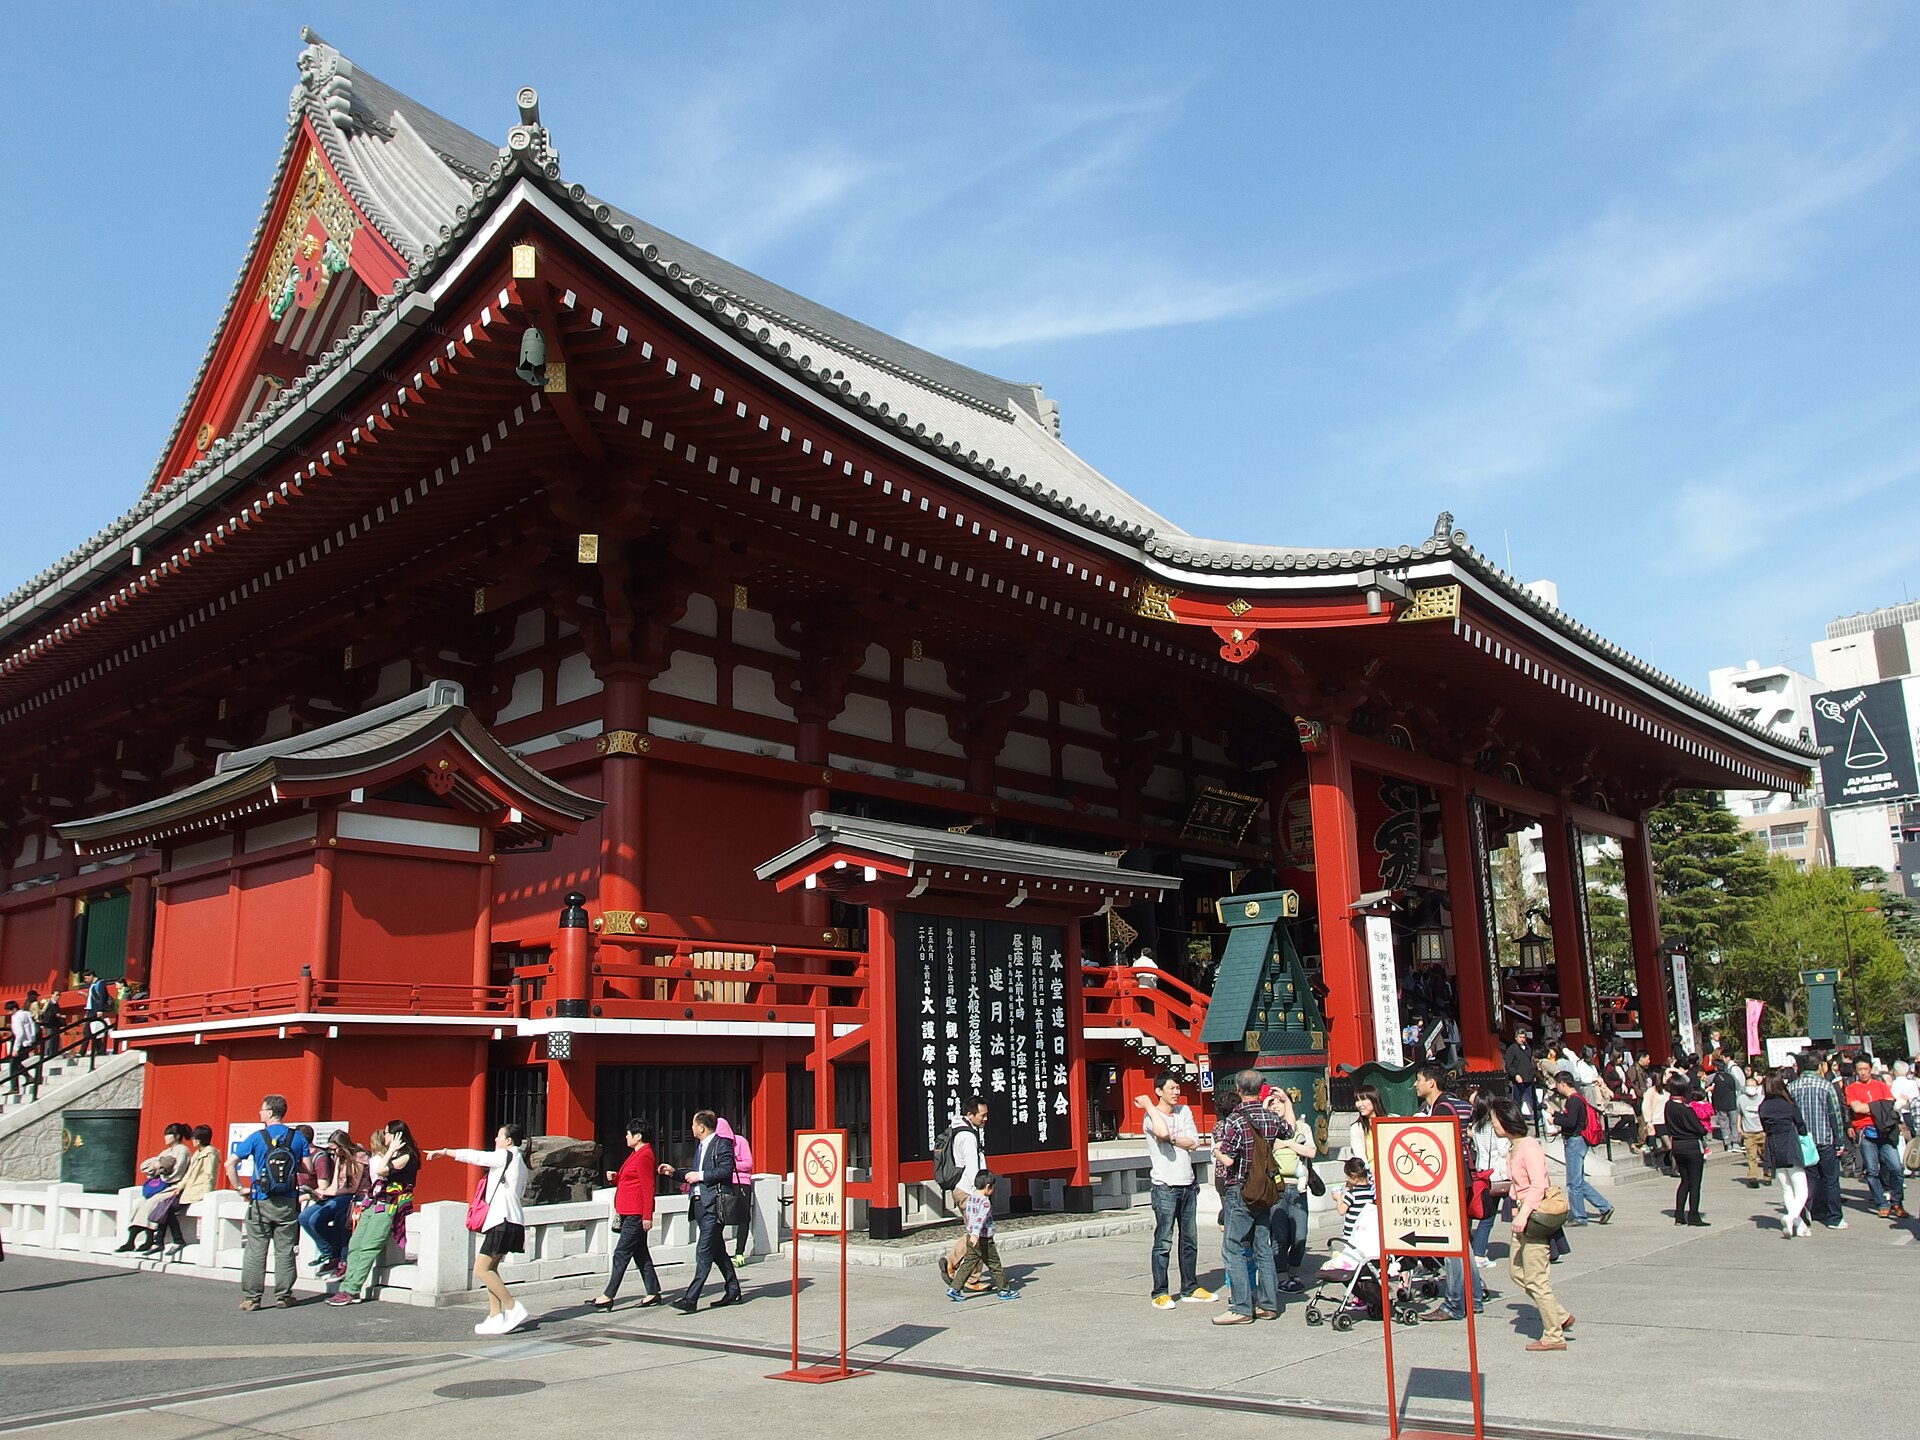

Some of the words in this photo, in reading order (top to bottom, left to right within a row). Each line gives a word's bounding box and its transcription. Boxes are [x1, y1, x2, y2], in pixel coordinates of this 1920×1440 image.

[1841, 690, 1867, 712] Here!
[1847, 772, 1893, 786] AMUSE
[1842, 780, 1899, 796] MUSEUM
[989, 967, 1006, 1093] 連月法要
[1049, 949, 1069, 1115] 本堂連日法会
[805, 1192, 835, 1206] 自転車
[1391, 1194, 1450, 1205] 自転車の方は
[1402, 1205, 1441, 1216] 本堂裏を
[800, 1211, 840, 1225] 進入禁止
